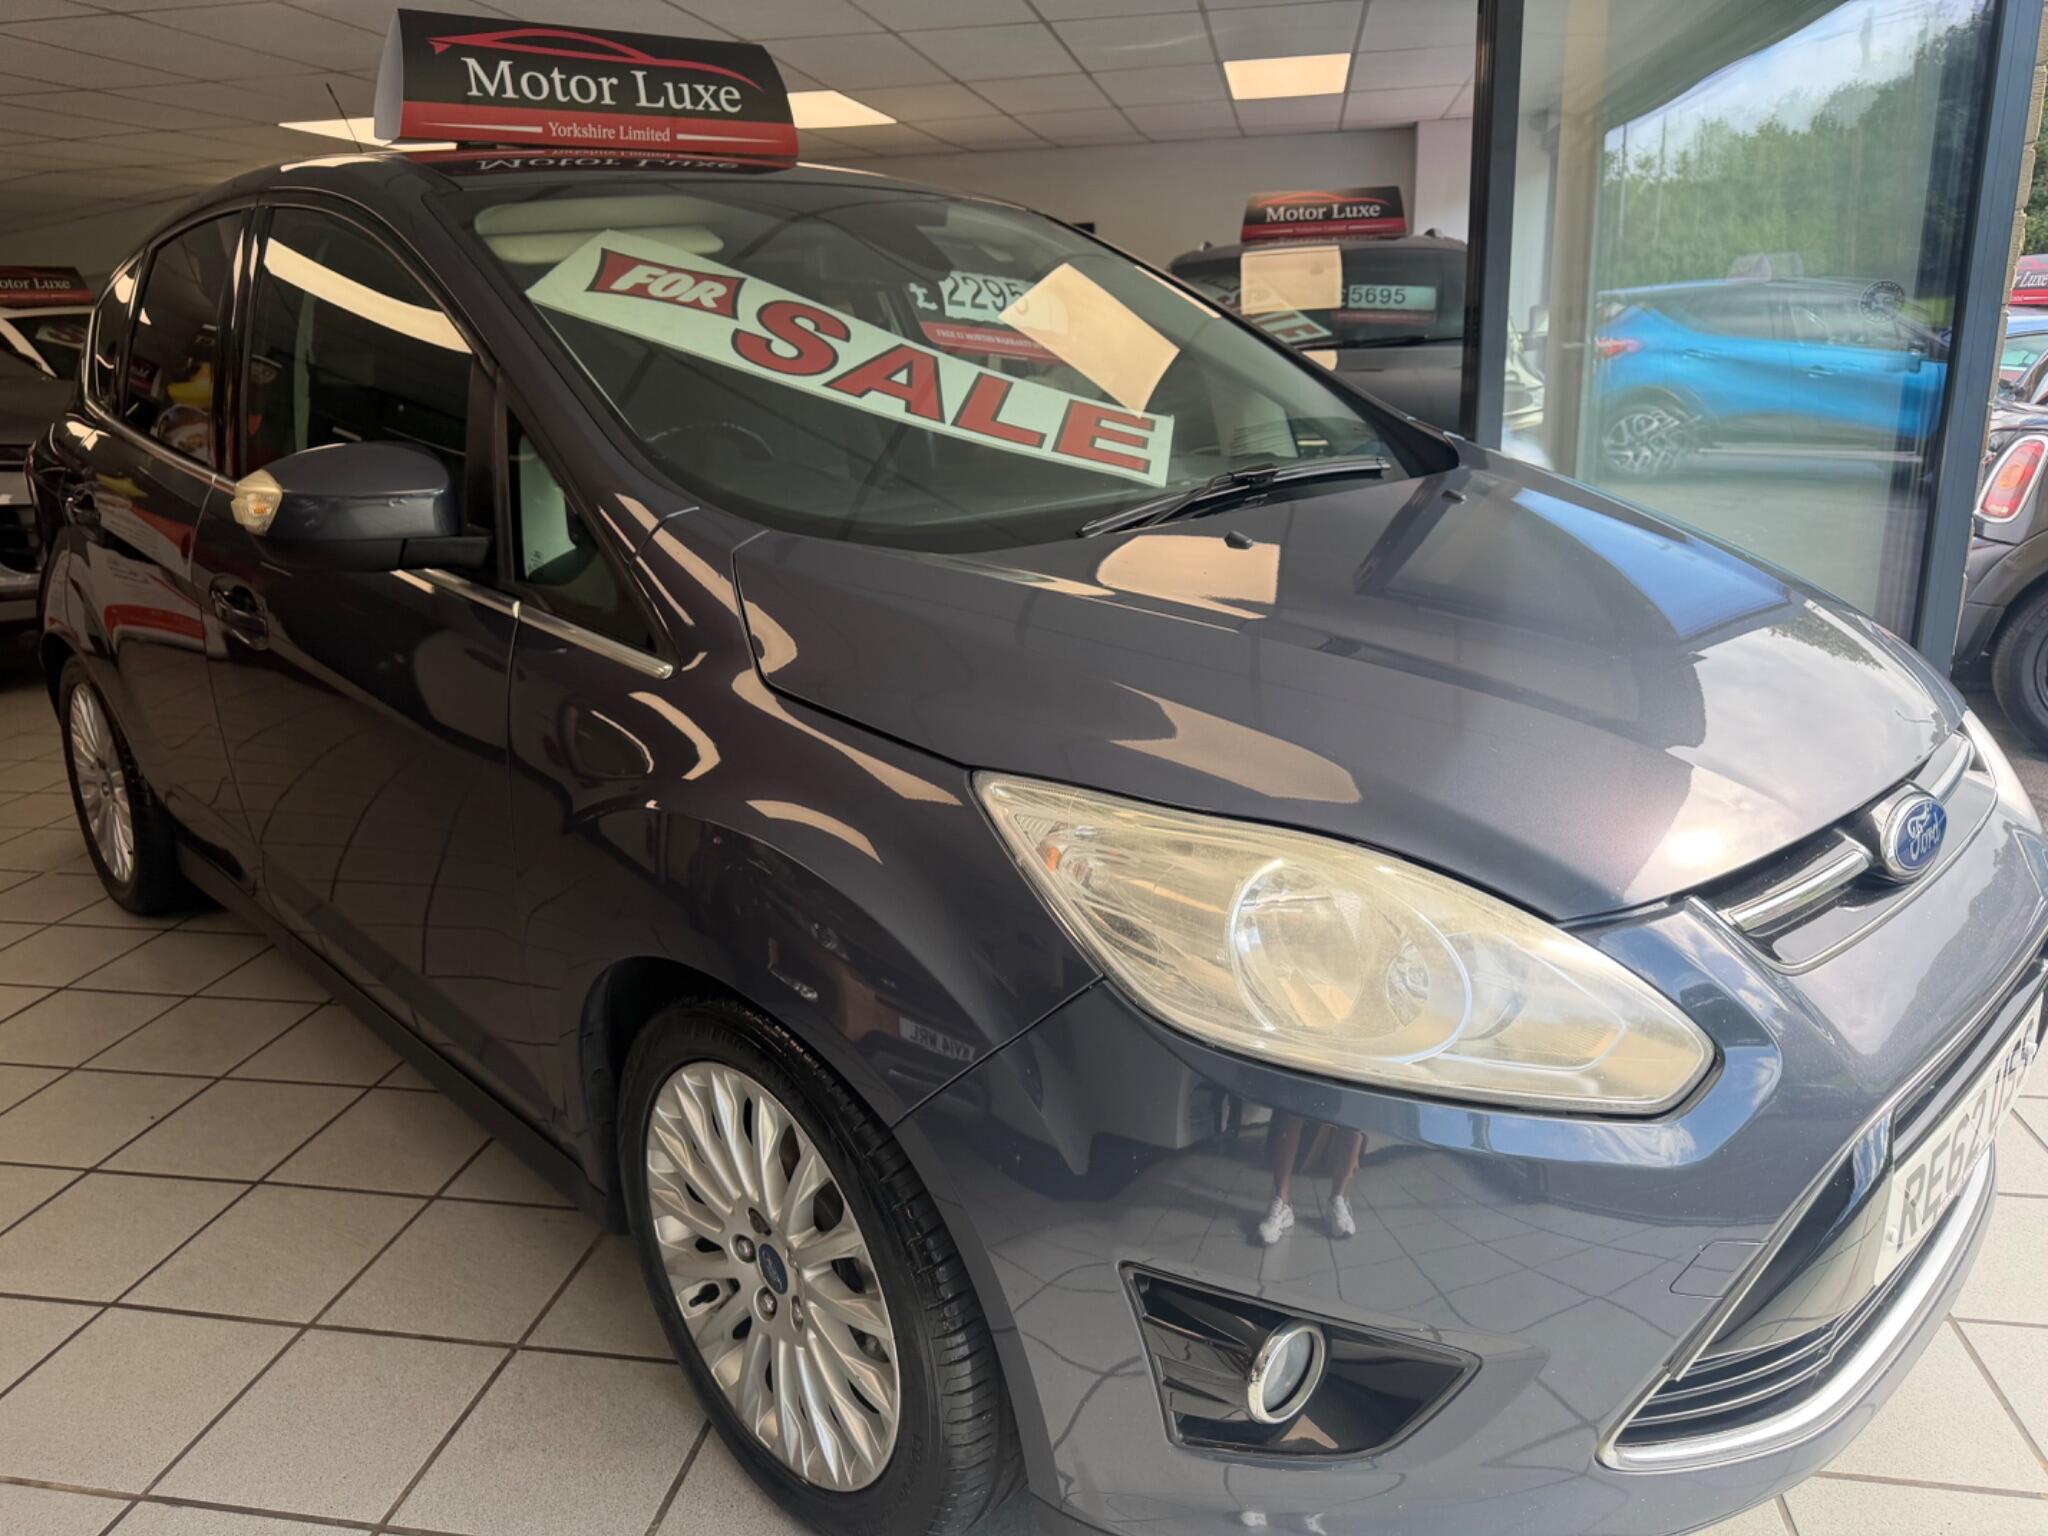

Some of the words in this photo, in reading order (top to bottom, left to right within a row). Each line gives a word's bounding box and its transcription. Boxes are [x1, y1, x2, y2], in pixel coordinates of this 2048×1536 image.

[461, 56, 618, 106] Motor
[631, 69, 743, 113] Luxe
[548, 122, 616, 140] Yorkshire
[619, 126, 671, 142] Limited
[1265, 205, 1327, 223] Motor
[1332, 202, 1381, 219] Luxe
[33, 277, 72, 290] Luxe
[610, 265, 727, 308] FOR
[730, 299, 1156, 475] SALE
[1907, 801, 1943, 860] Ford
[1897, 1087, 1988, 1253] RE62
